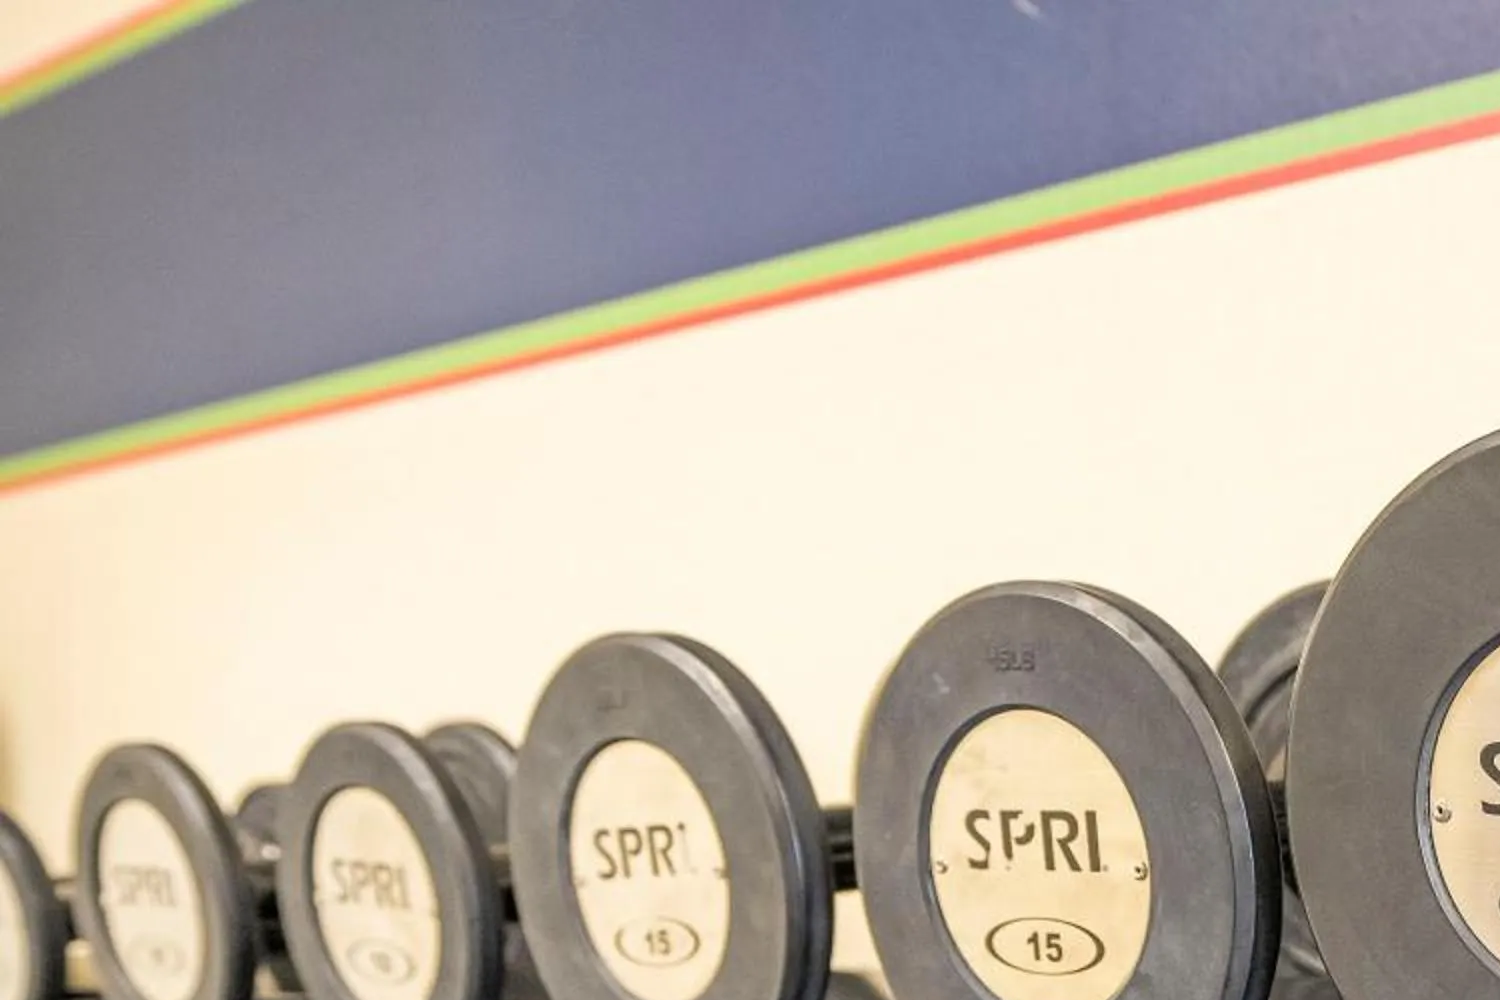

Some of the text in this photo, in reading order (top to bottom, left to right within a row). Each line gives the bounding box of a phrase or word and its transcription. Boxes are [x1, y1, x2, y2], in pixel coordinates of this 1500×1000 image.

[964, 808, 1101, 873] SPRI
[645, 928, 672, 957] 15
[1027, 930, 1063, 963] 15
